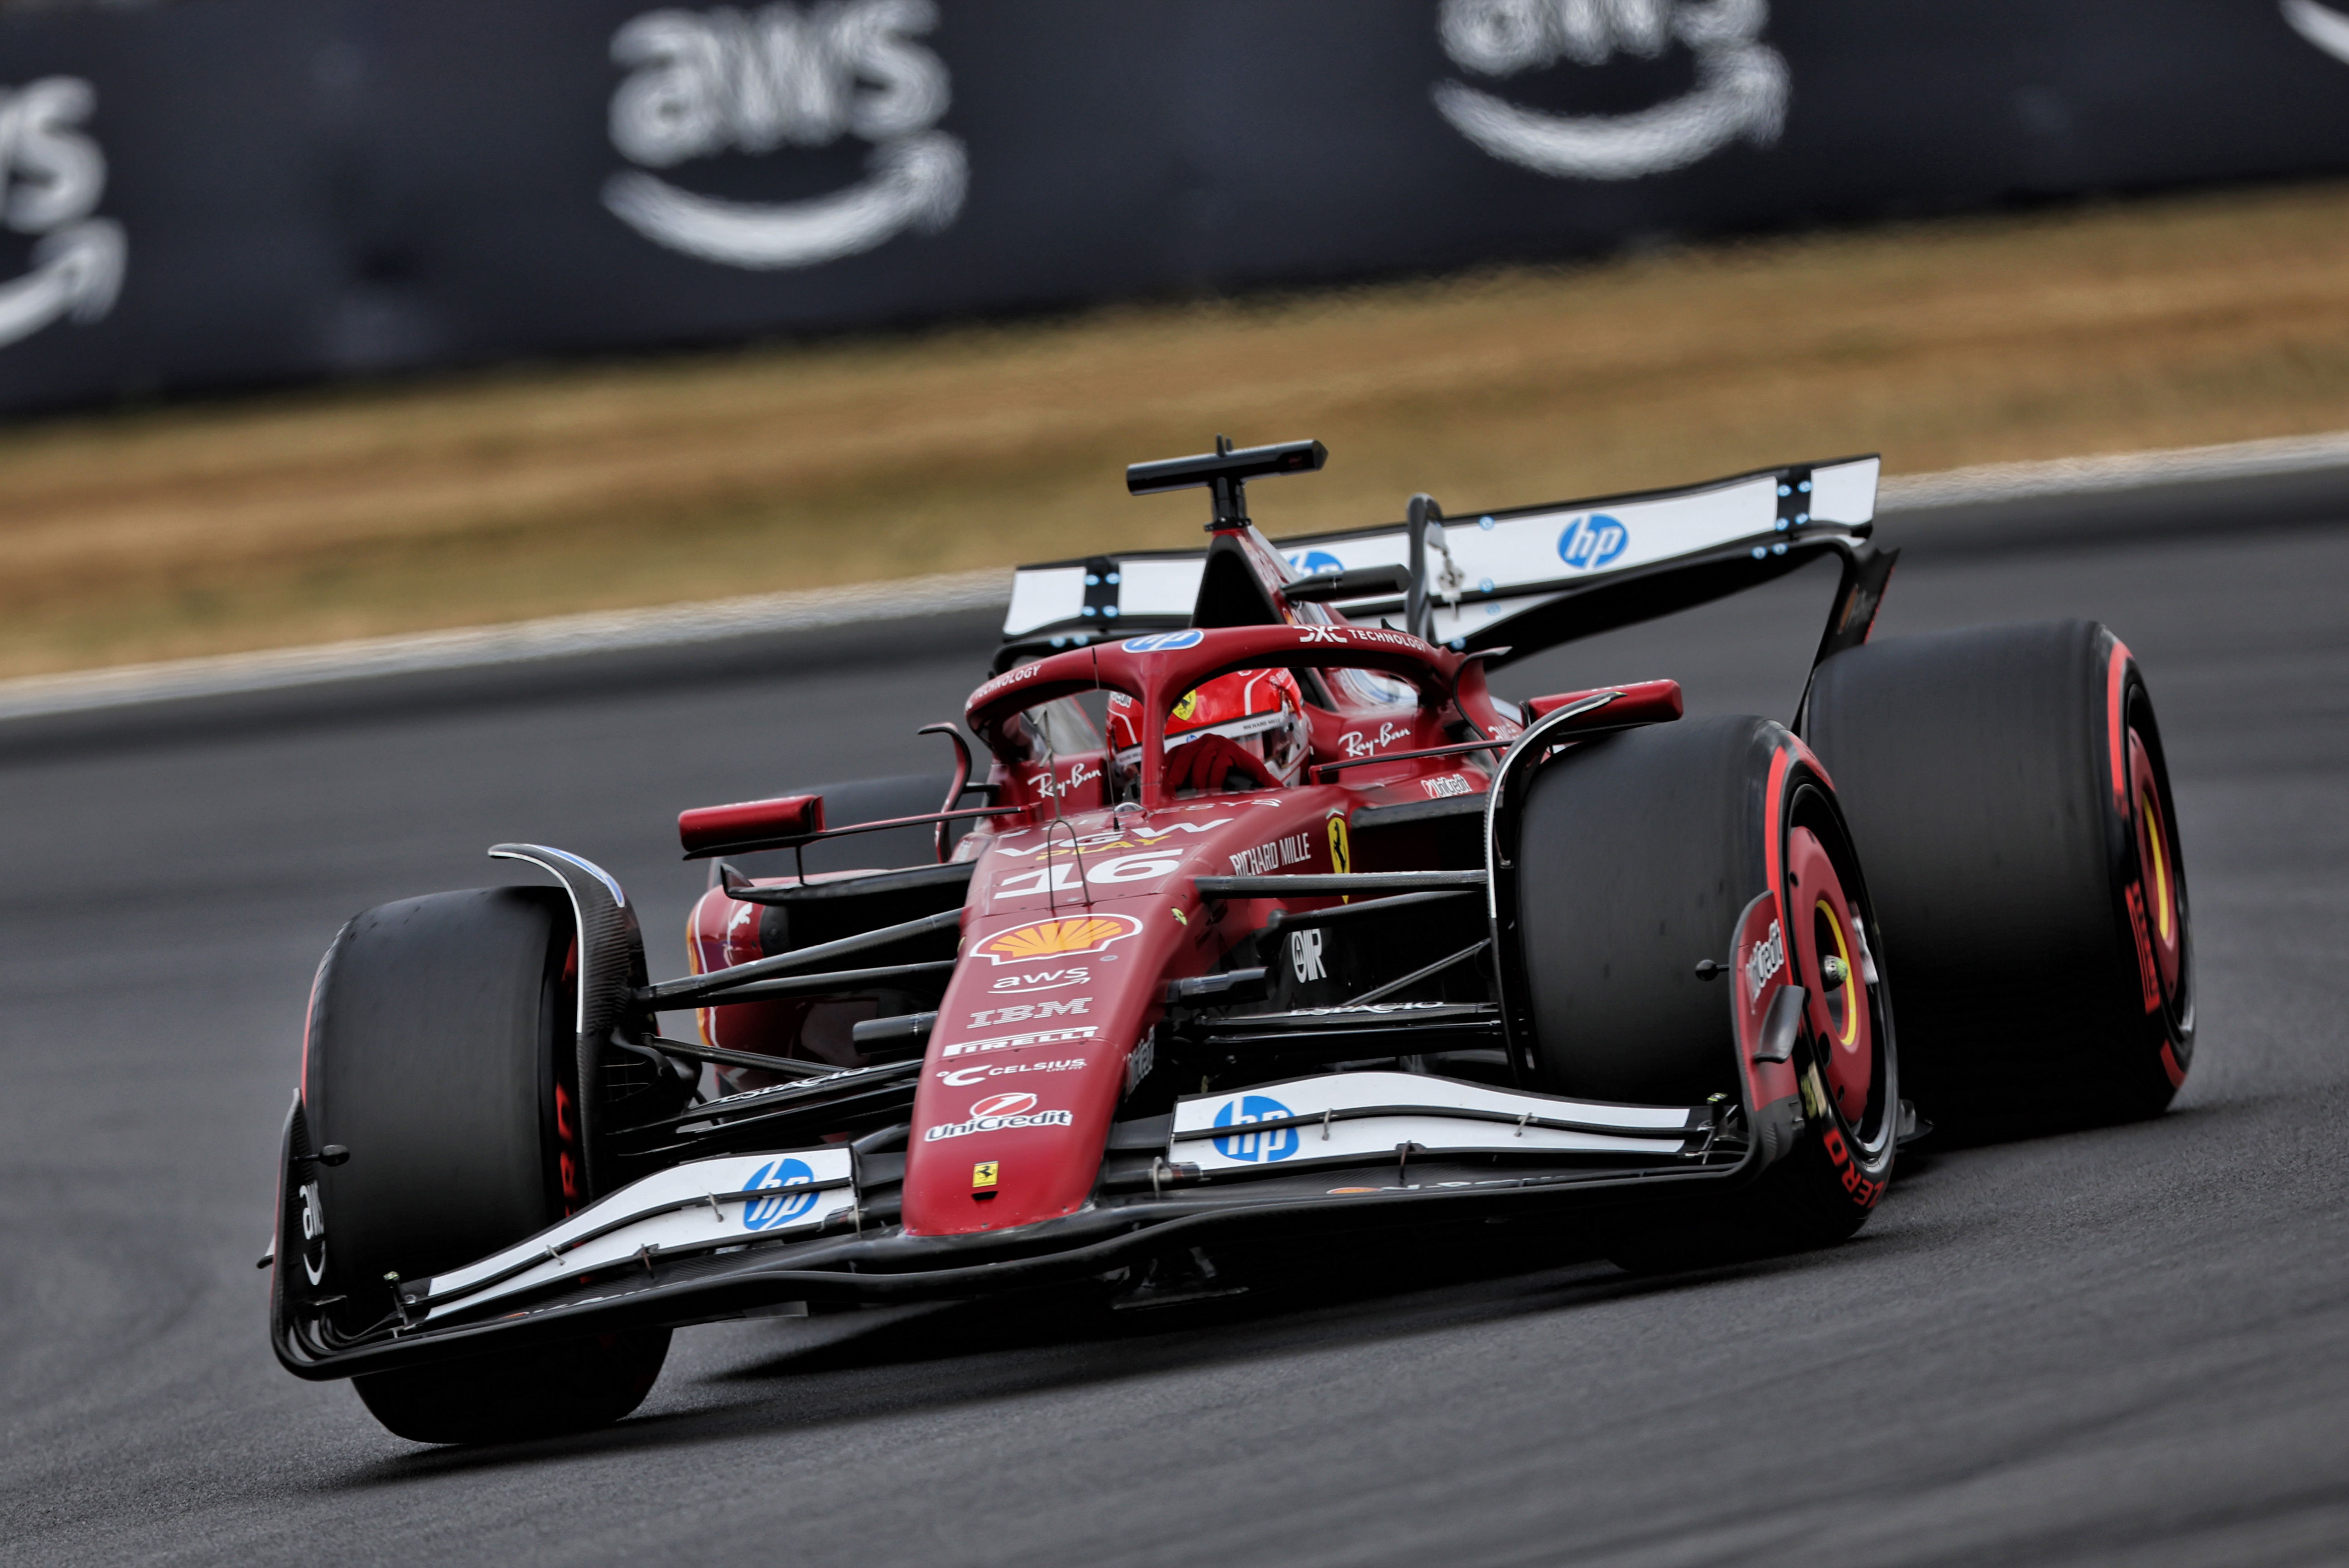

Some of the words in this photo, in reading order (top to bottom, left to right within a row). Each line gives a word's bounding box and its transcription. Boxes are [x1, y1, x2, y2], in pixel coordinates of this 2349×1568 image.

[1563, 514, 1625, 569] hp
[1293, 626, 1348, 643] DXC
[1347, 629, 1426, 652] TECHNOLOGY
[1337, 721, 1411, 757] Ray-Ban
[1027, 763, 1102, 798] Ray-Ban
[995, 818, 1234, 857] VGW
[1036, 835, 1172, 860] PLAY
[1229, 842, 1279, 876] RICHARD
[1279, 832, 1312, 866] MILLE
[993, 849, 1184, 899] 16
[993, 967, 1089, 989] aws
[966, 997, 1093, 1029] IBM
[942, 1026, 1100, 1057] PIRELLI
[988, 1058, 1086, 1076] CELSIUS
[926, 1110, 1071, 1141] UniCredit
[1226, 1096, 1290, 1162] hp
[747, 1158, 813, 1230] hp
